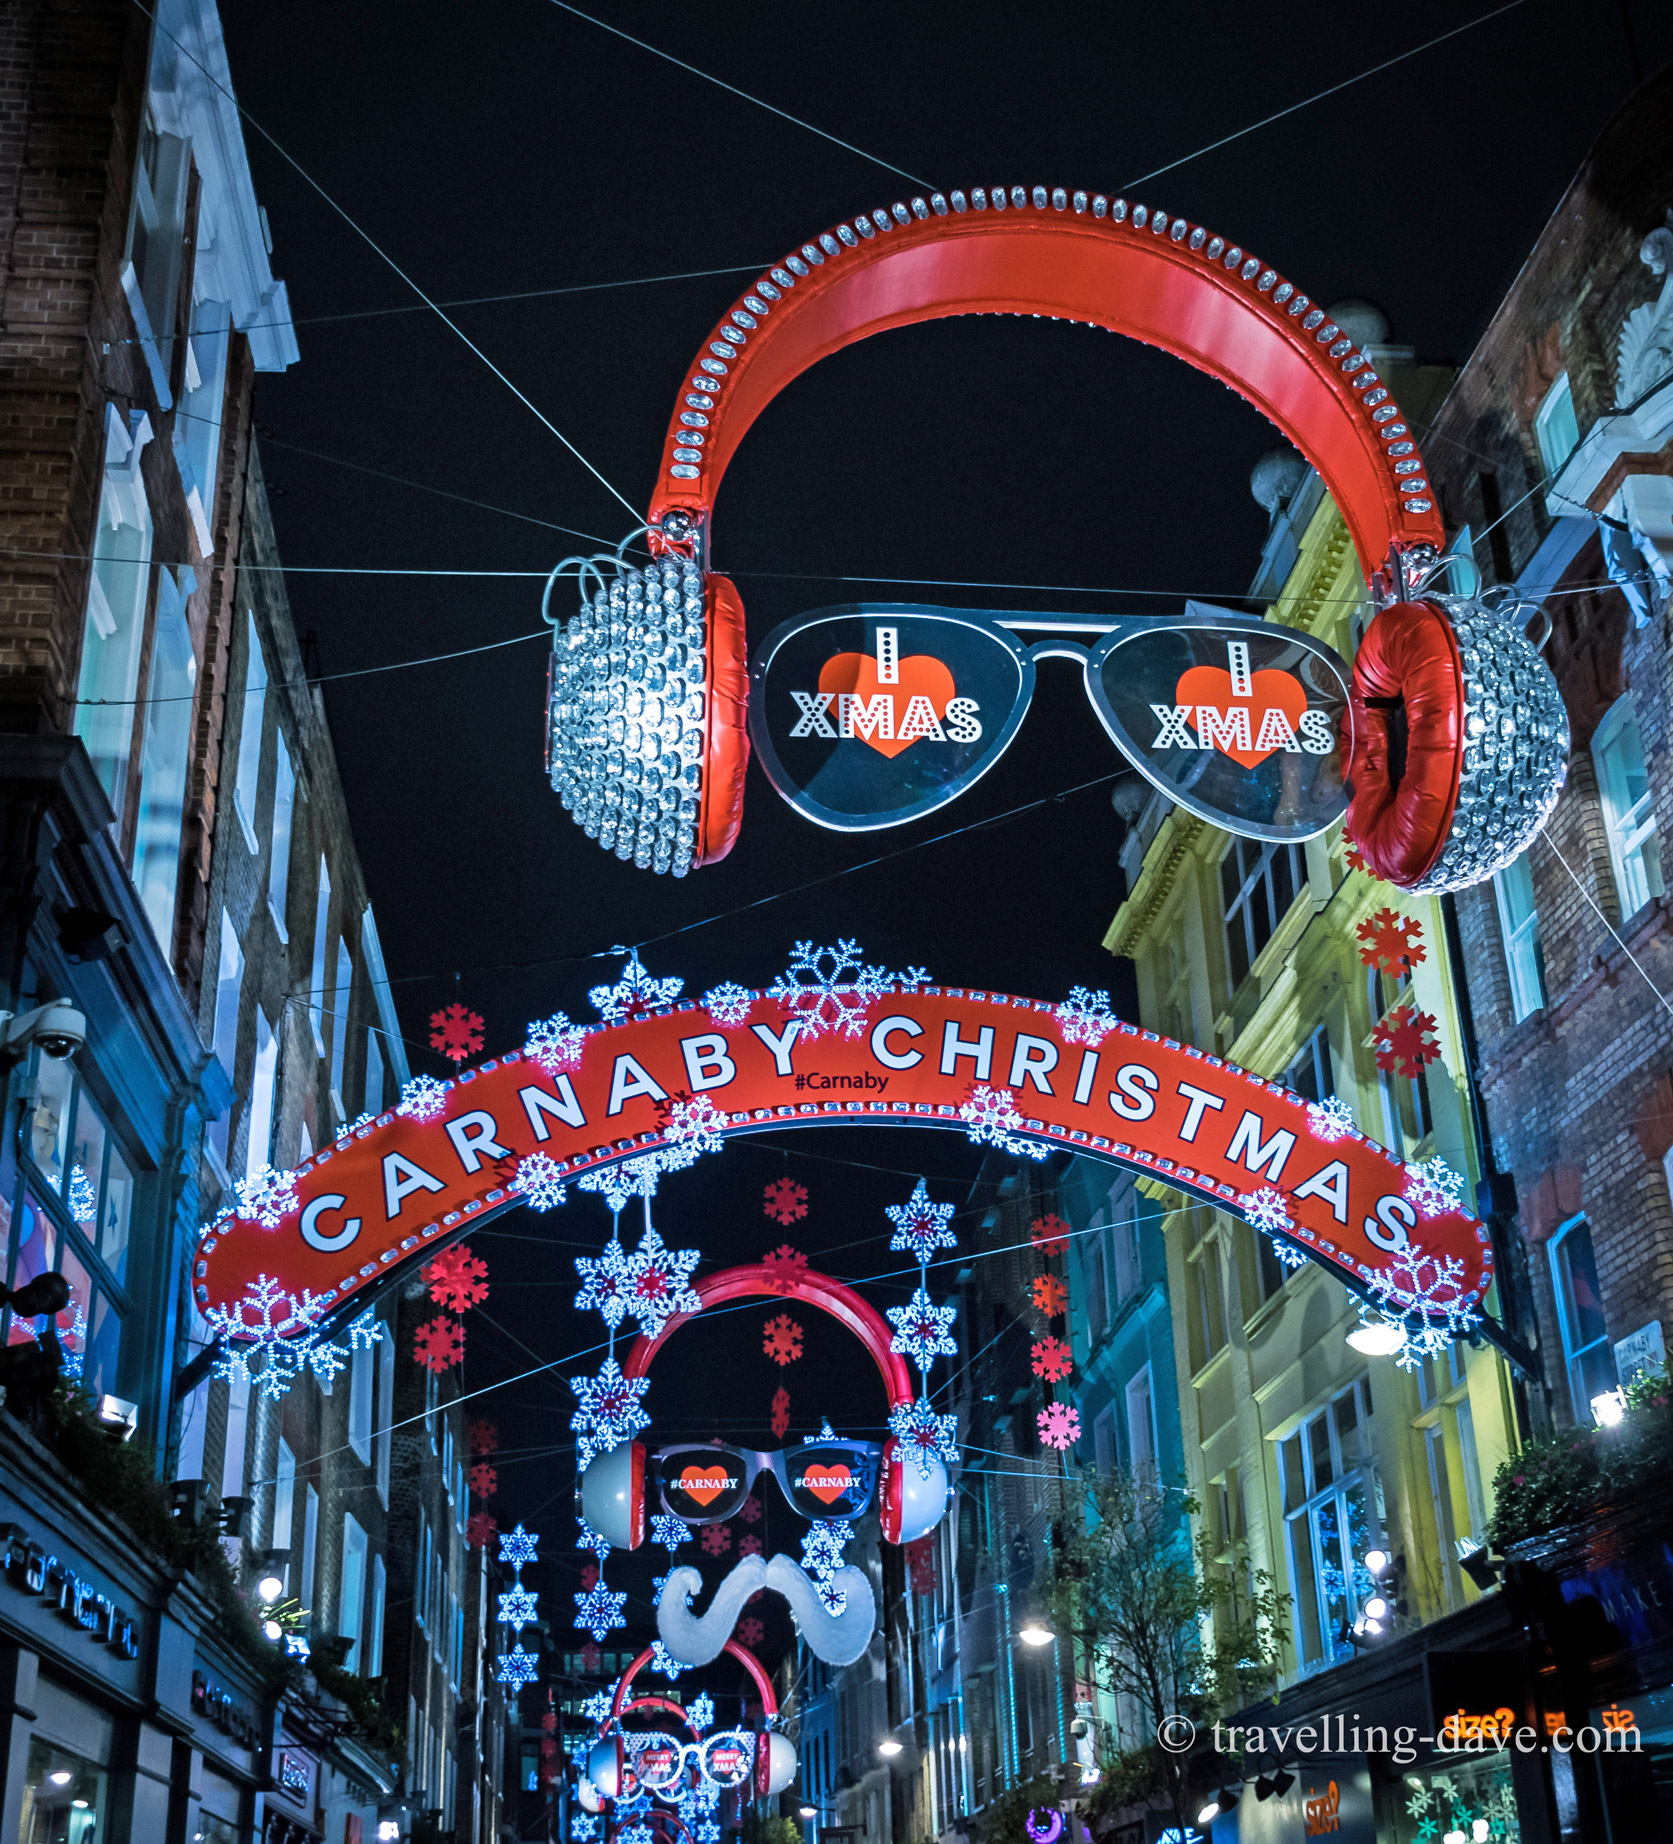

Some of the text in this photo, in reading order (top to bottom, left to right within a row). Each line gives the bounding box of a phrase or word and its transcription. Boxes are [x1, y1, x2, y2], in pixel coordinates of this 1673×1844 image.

[876, 626, 899, 684] I
[1227, 641, 1253, 697] I
[789, 691, 983, 743] XMAS
[1150, 704, 1335, 755] XMAS
[794, 1071, 889, 1094] #Carnaby
[299, 1015, 1418, 1254] CARNABY CHRISTMAS
[670, 1478, 739, 1489] #CARNABY
[794, 1477, 861, 1488] #CARNABY
[1601, 1581, 1663, 1624] MAKE
[1443, 1707, 1515, 1739] size?
[1306, 1780, 1340, 1837] size?
